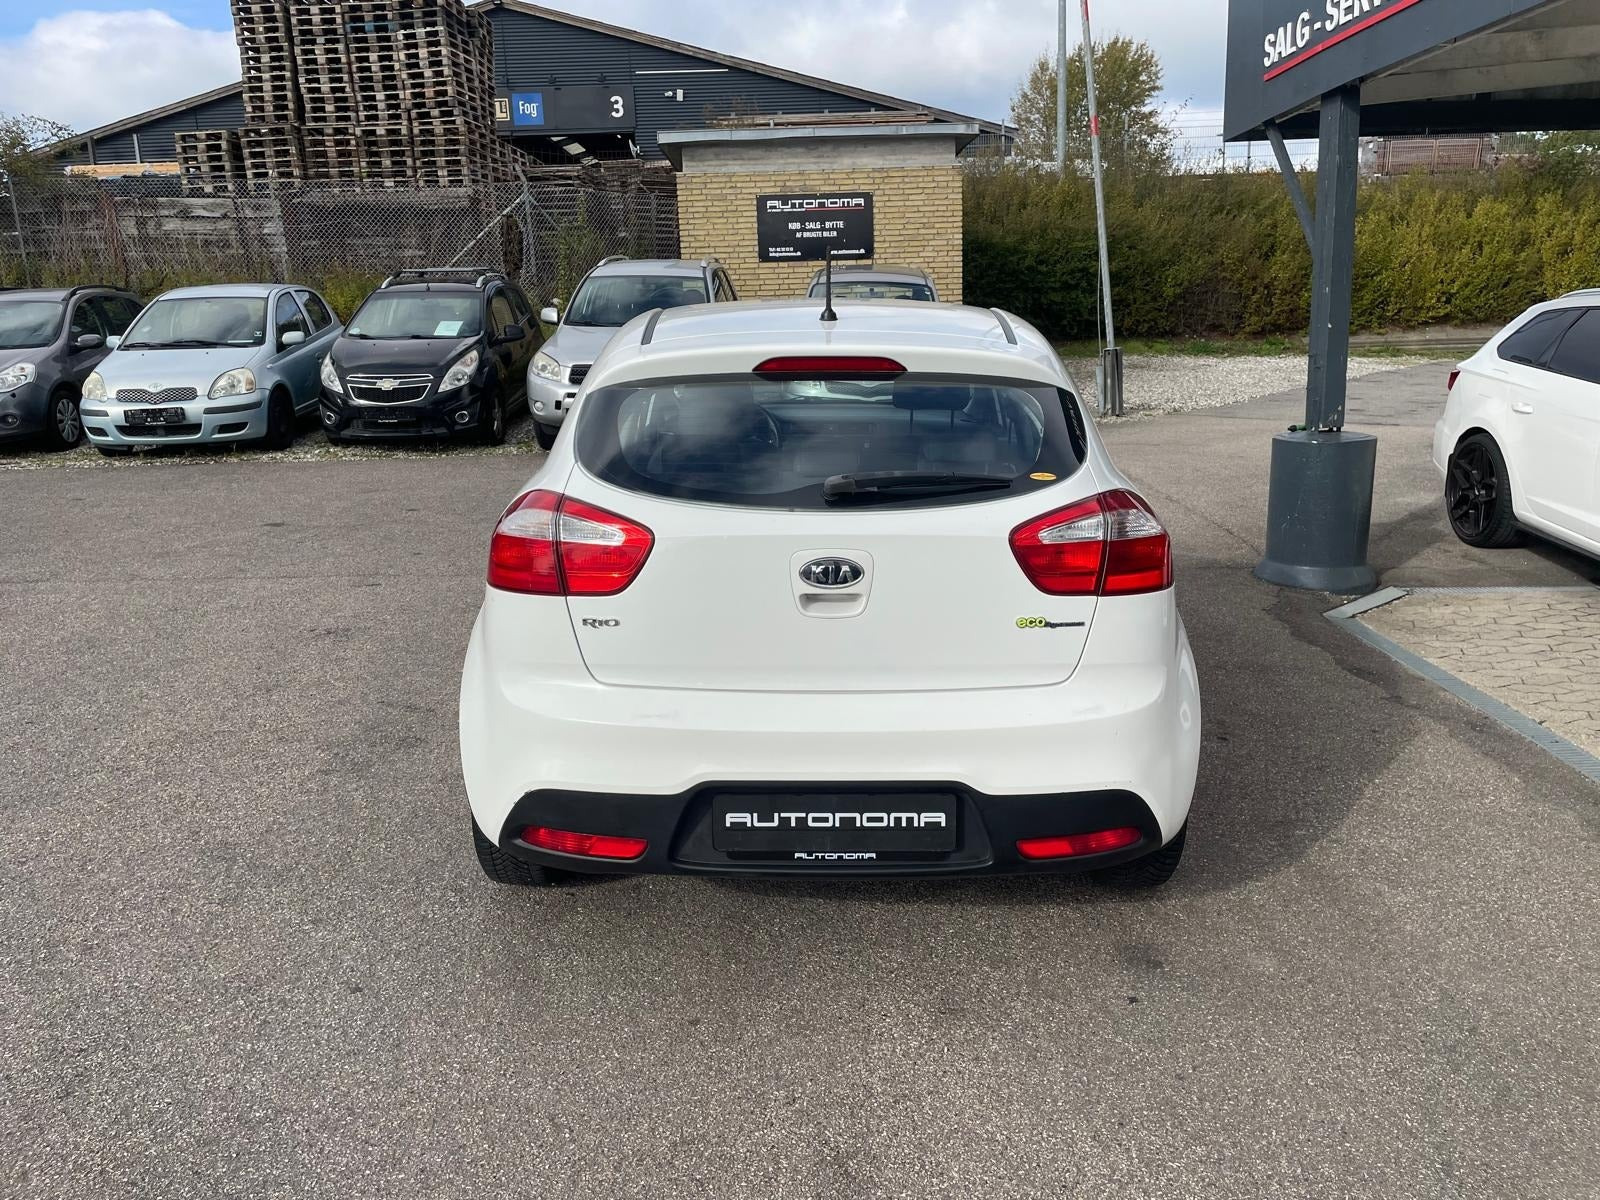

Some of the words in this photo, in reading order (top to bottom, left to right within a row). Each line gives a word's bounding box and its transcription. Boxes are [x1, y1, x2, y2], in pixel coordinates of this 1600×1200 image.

[1263, 11, 1311, 68] SALG
[519, 101, 538, 118] Fog
[609, 95, 625, 118] 3
[766, 198, 865, 209] AUTONOMA
[805, 221, 821, 229] SALG
[825, 220, 845, 229] BYTTE
[810, 565, 854, 584] KIA
[725, 812, 946, 827] AUTONOMA
[794, 852, 877, 860] AUTONOMA
